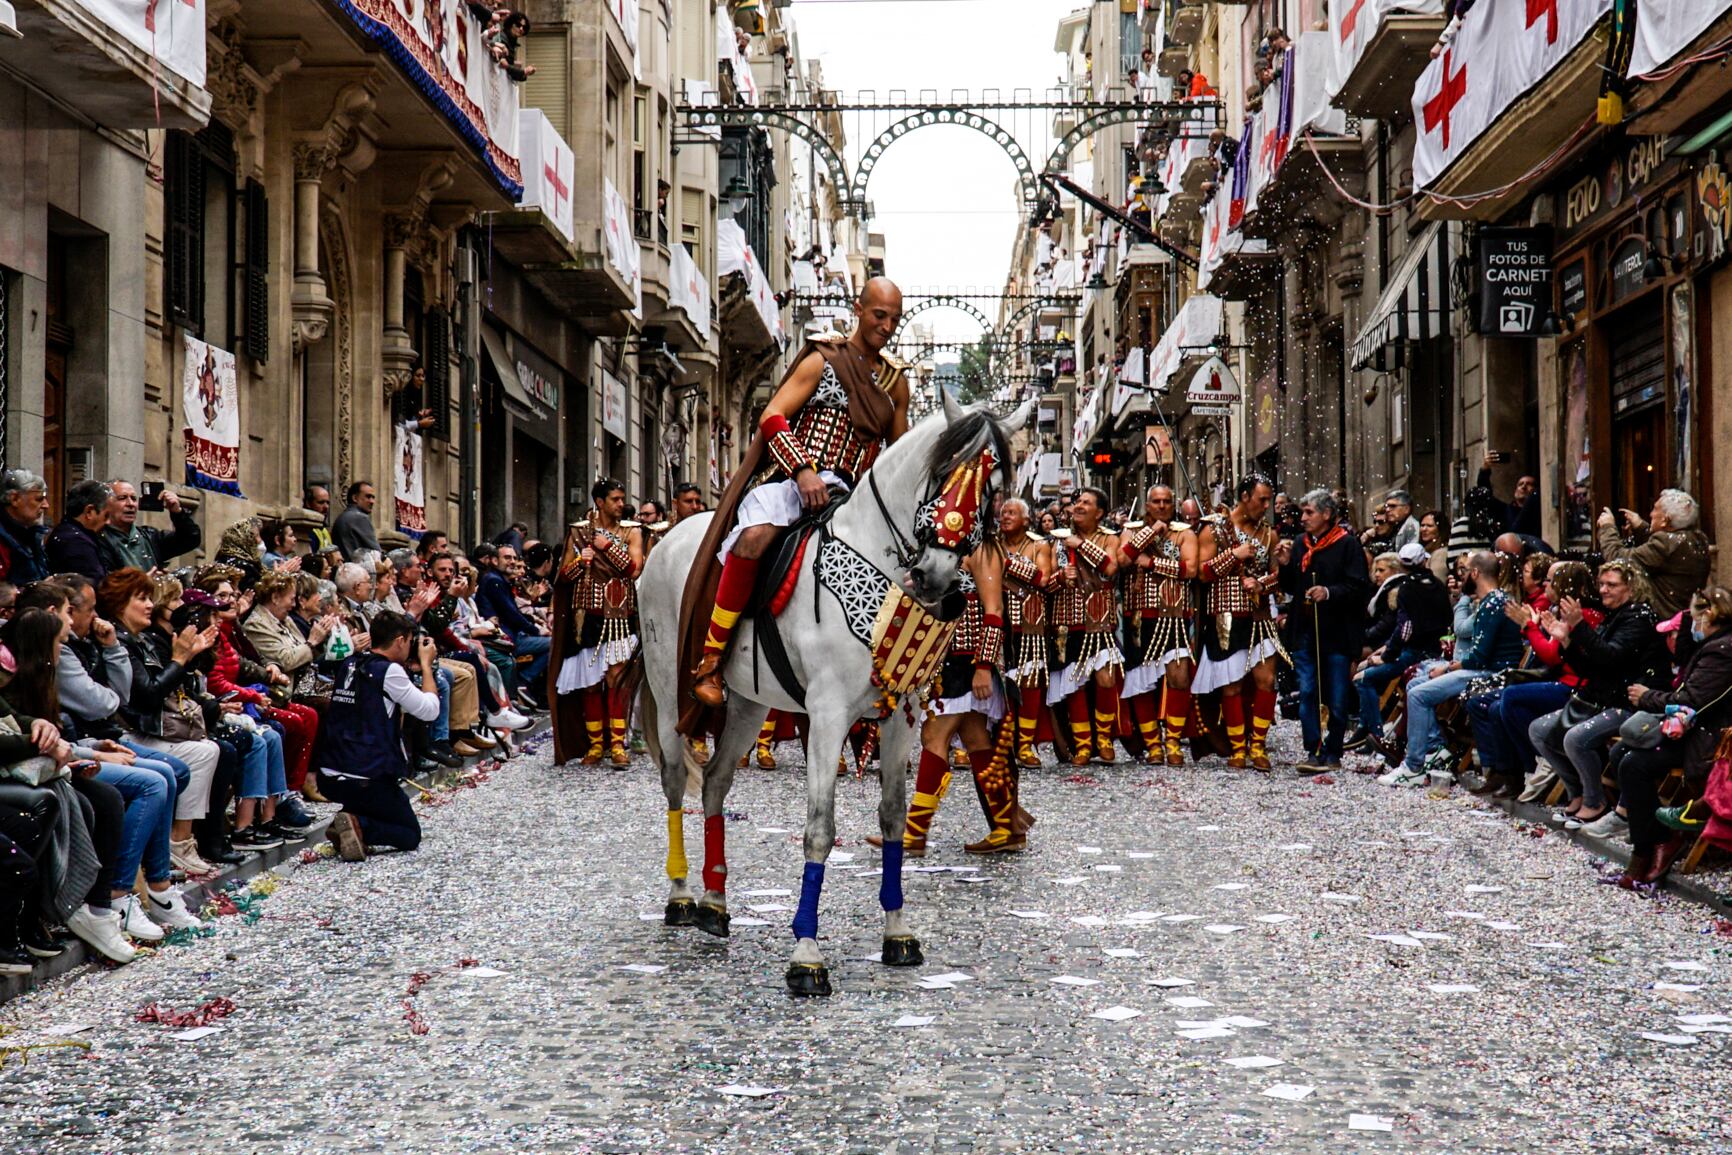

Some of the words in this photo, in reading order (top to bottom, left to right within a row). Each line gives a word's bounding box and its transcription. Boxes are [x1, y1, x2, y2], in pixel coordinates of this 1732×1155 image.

[1566, 174, 1601, 229] FOTO
[1675, 210, 1684, 239] 10
[1507, 241, 1528, 252] TUS
[1489, 254, 1527, 265] FOTOS
[1530, 254, 1546, 265] DE
[1486, 268, 1552, 282] CARNET
[1503, 284, 1533, 296] AQUÍ
[1187, 391, 1241, 403] Cruzcampo
